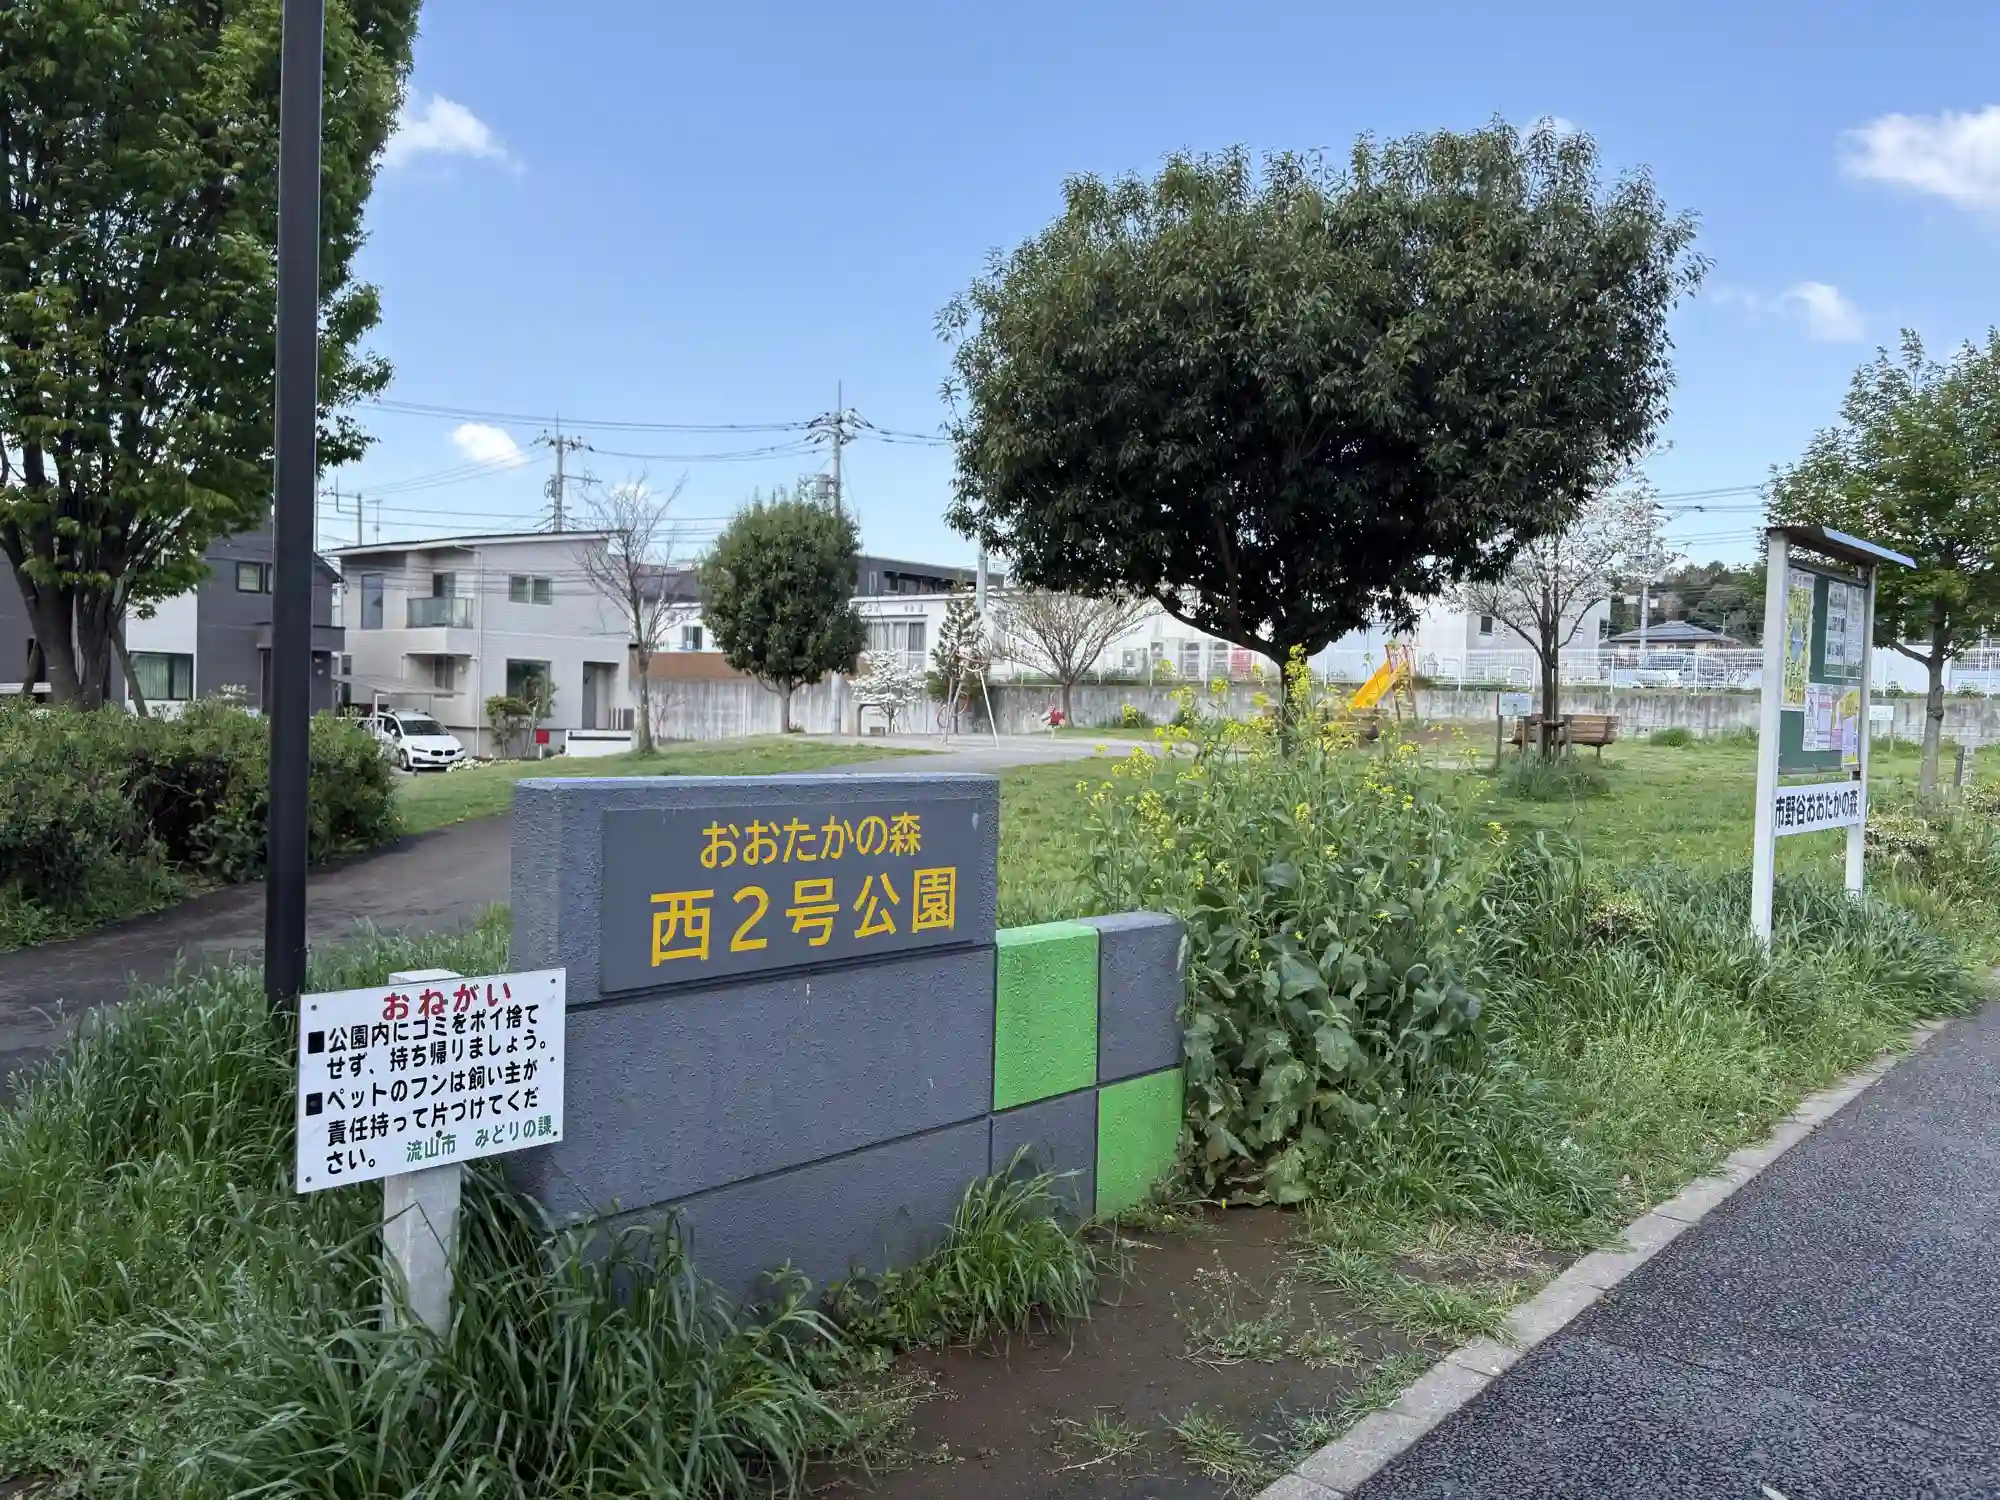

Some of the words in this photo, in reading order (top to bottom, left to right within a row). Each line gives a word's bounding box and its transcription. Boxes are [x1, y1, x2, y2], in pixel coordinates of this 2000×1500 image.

[1775, 789, 1860, 828] 市野谷おおたかの森
[700, 811, 922, 869] おおたかの森
[650, 866, 957, 967] 西2号公園
[382, 983, 512, 1021] おねがい
[327, 1059, 538, 1110] ペットのフンは飼い主が
[327, 1088, 539, 1147] 責任持って片づけてくだ
[406, 1134, 457, 1163] 流山市
[474, 1115, 553, 1148] みどりの課
[326, 1148, 376, 1175] さい。
